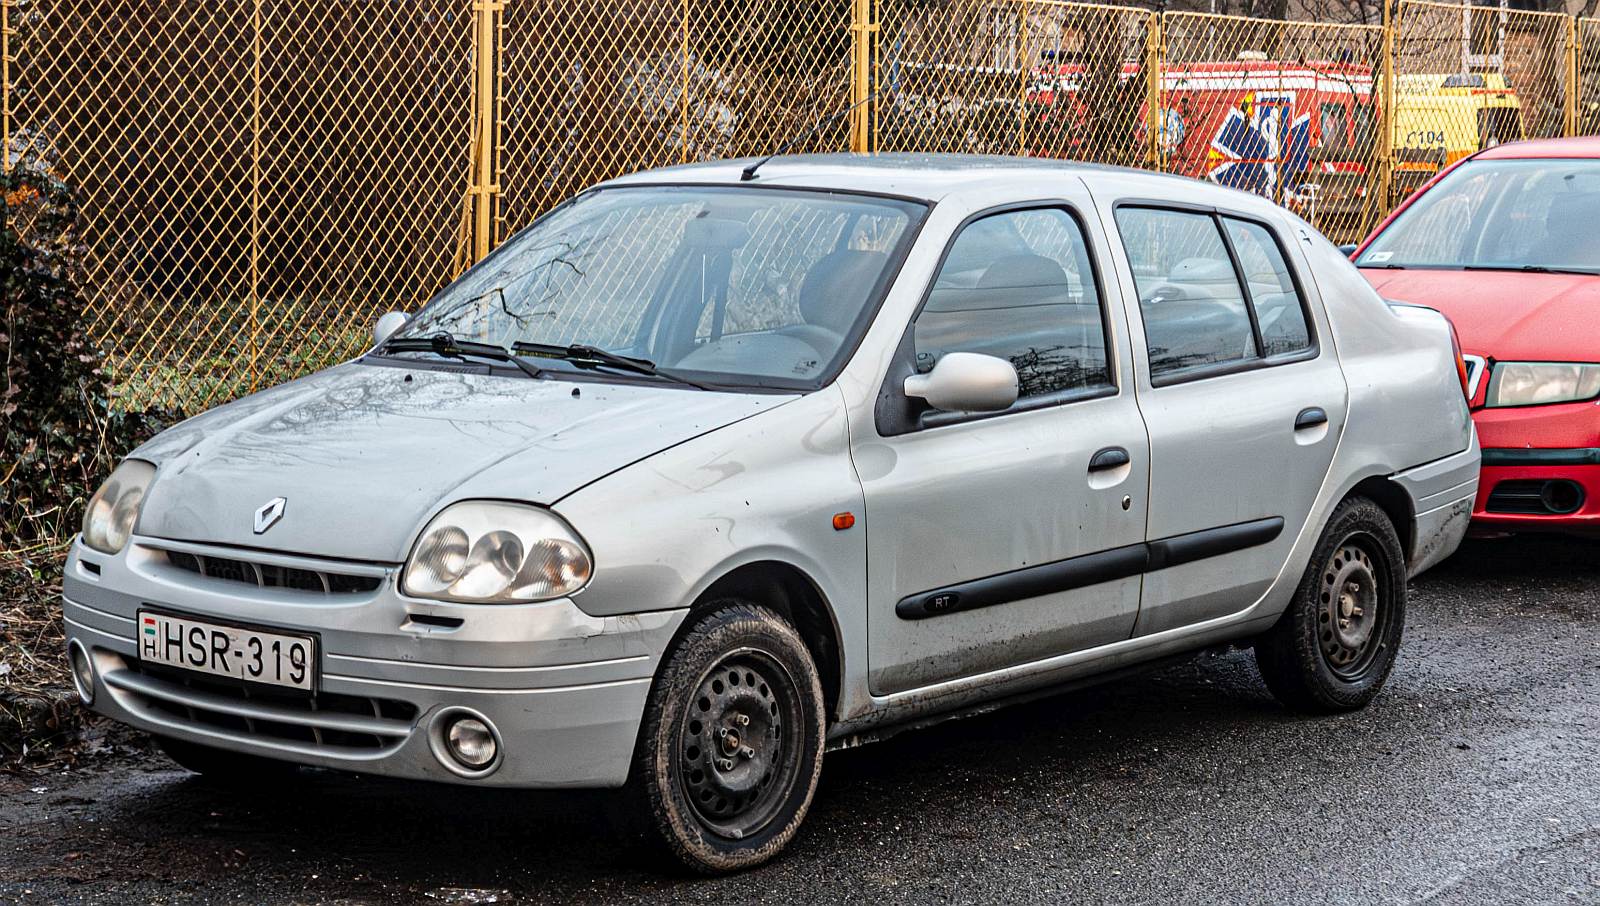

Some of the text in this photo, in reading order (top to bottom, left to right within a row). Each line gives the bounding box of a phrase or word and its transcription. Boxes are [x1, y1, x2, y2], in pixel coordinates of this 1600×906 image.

[935, 596, 950, 608] RT
[144, 638, 156, 657] H
[165, 621, 306, 684] HSR-319
